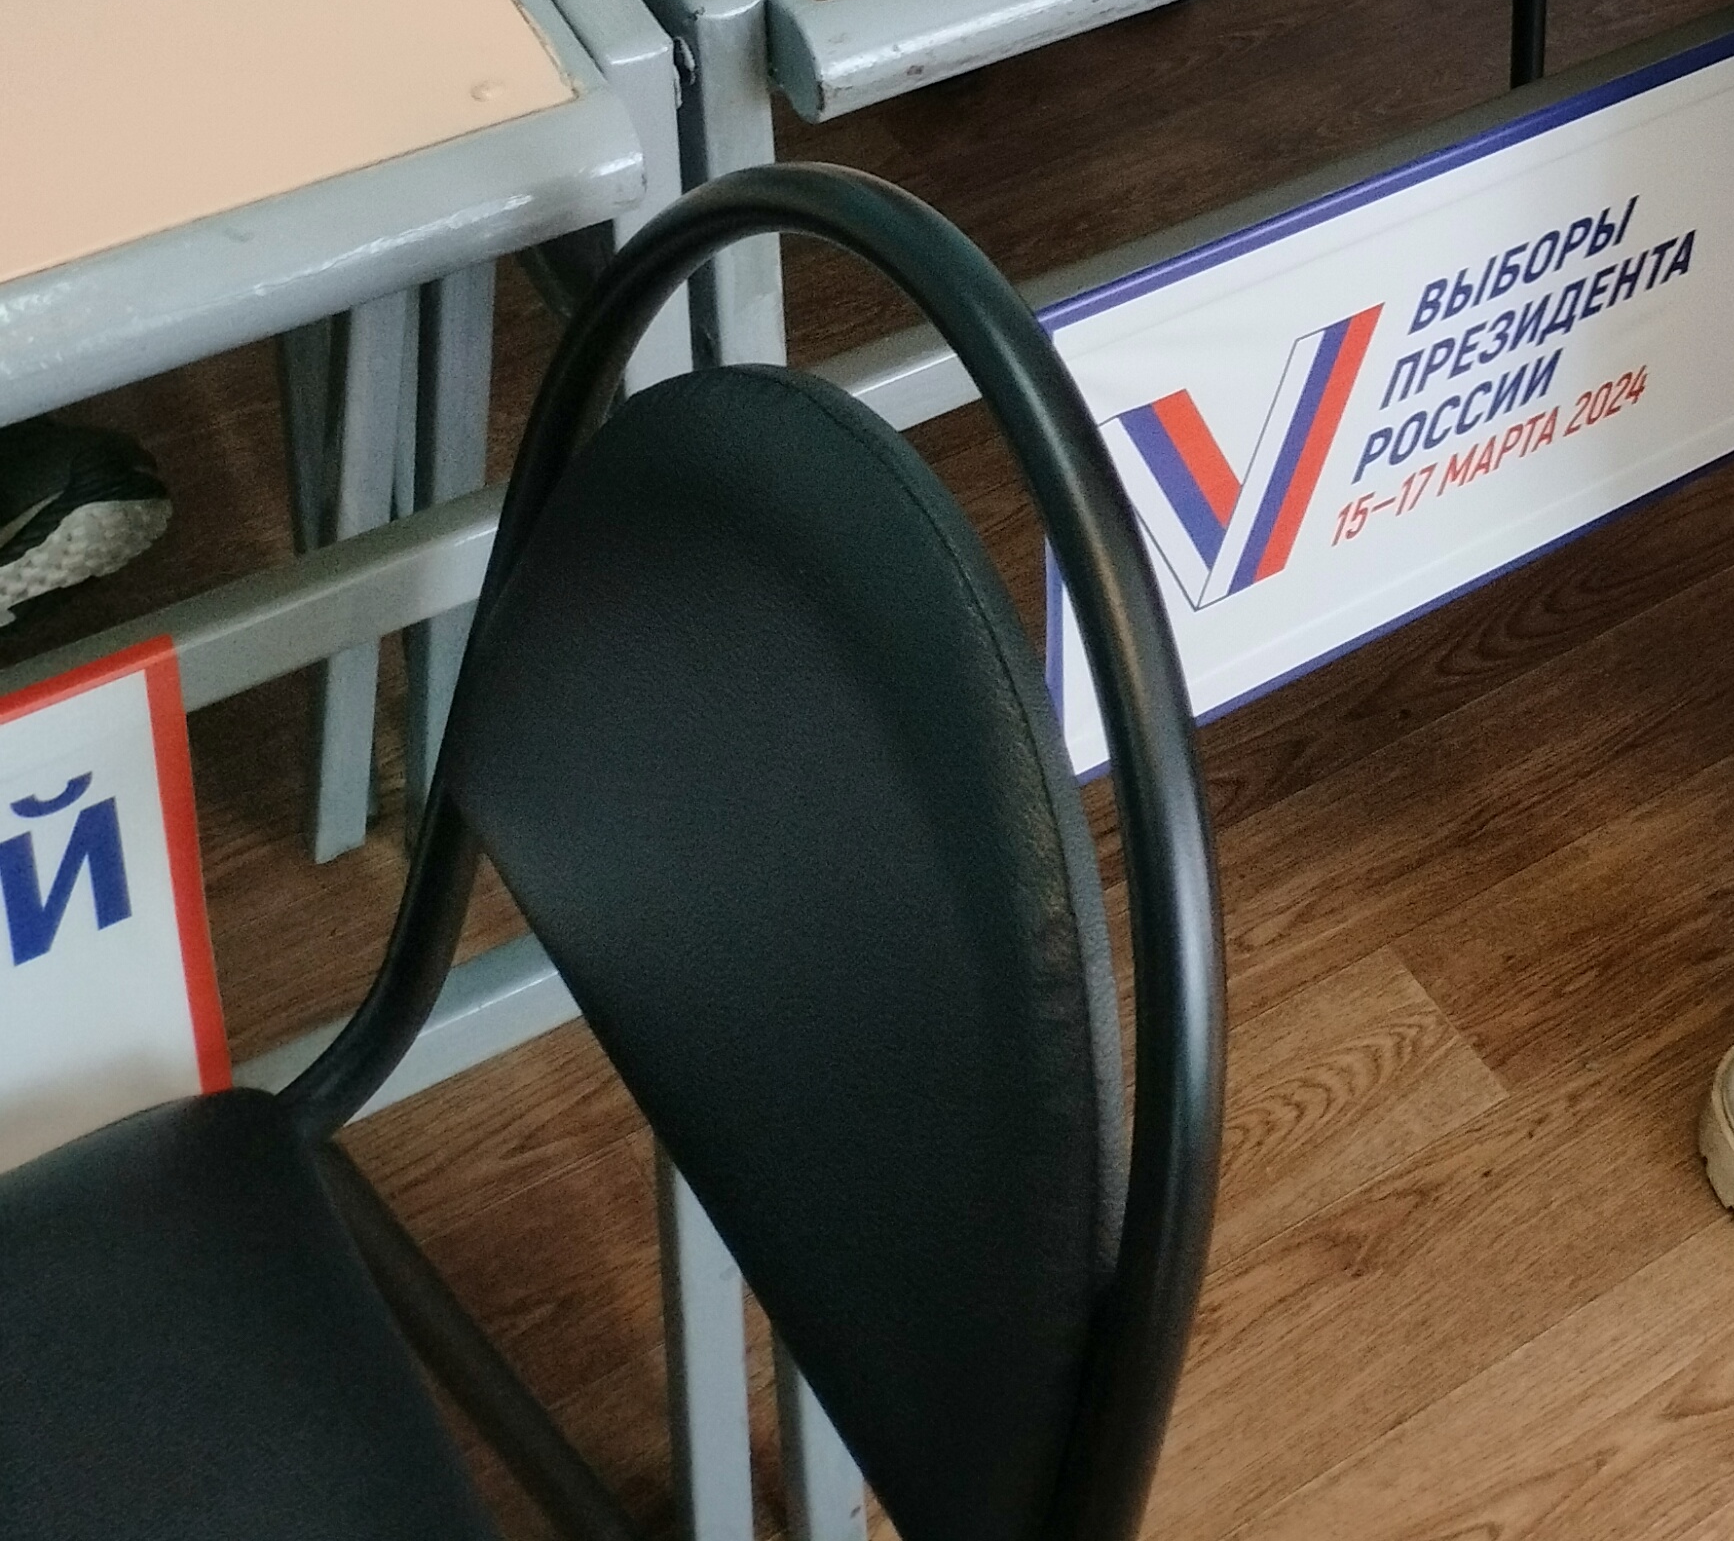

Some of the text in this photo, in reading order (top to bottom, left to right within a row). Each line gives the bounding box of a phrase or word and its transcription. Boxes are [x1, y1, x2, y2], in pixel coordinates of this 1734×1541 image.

[1379, 229, 1697, 410] ПРЕЗИДЕНТА
[1407, 194, 1640, 335] ВЫБОРЫ
[1351, 347, 1563, 485] РОССИИ
[1436, 405, 1560, 498] МАРТА
[1563, 365, 1648, 437] 2024
[0, 771, 133, 967] Й
